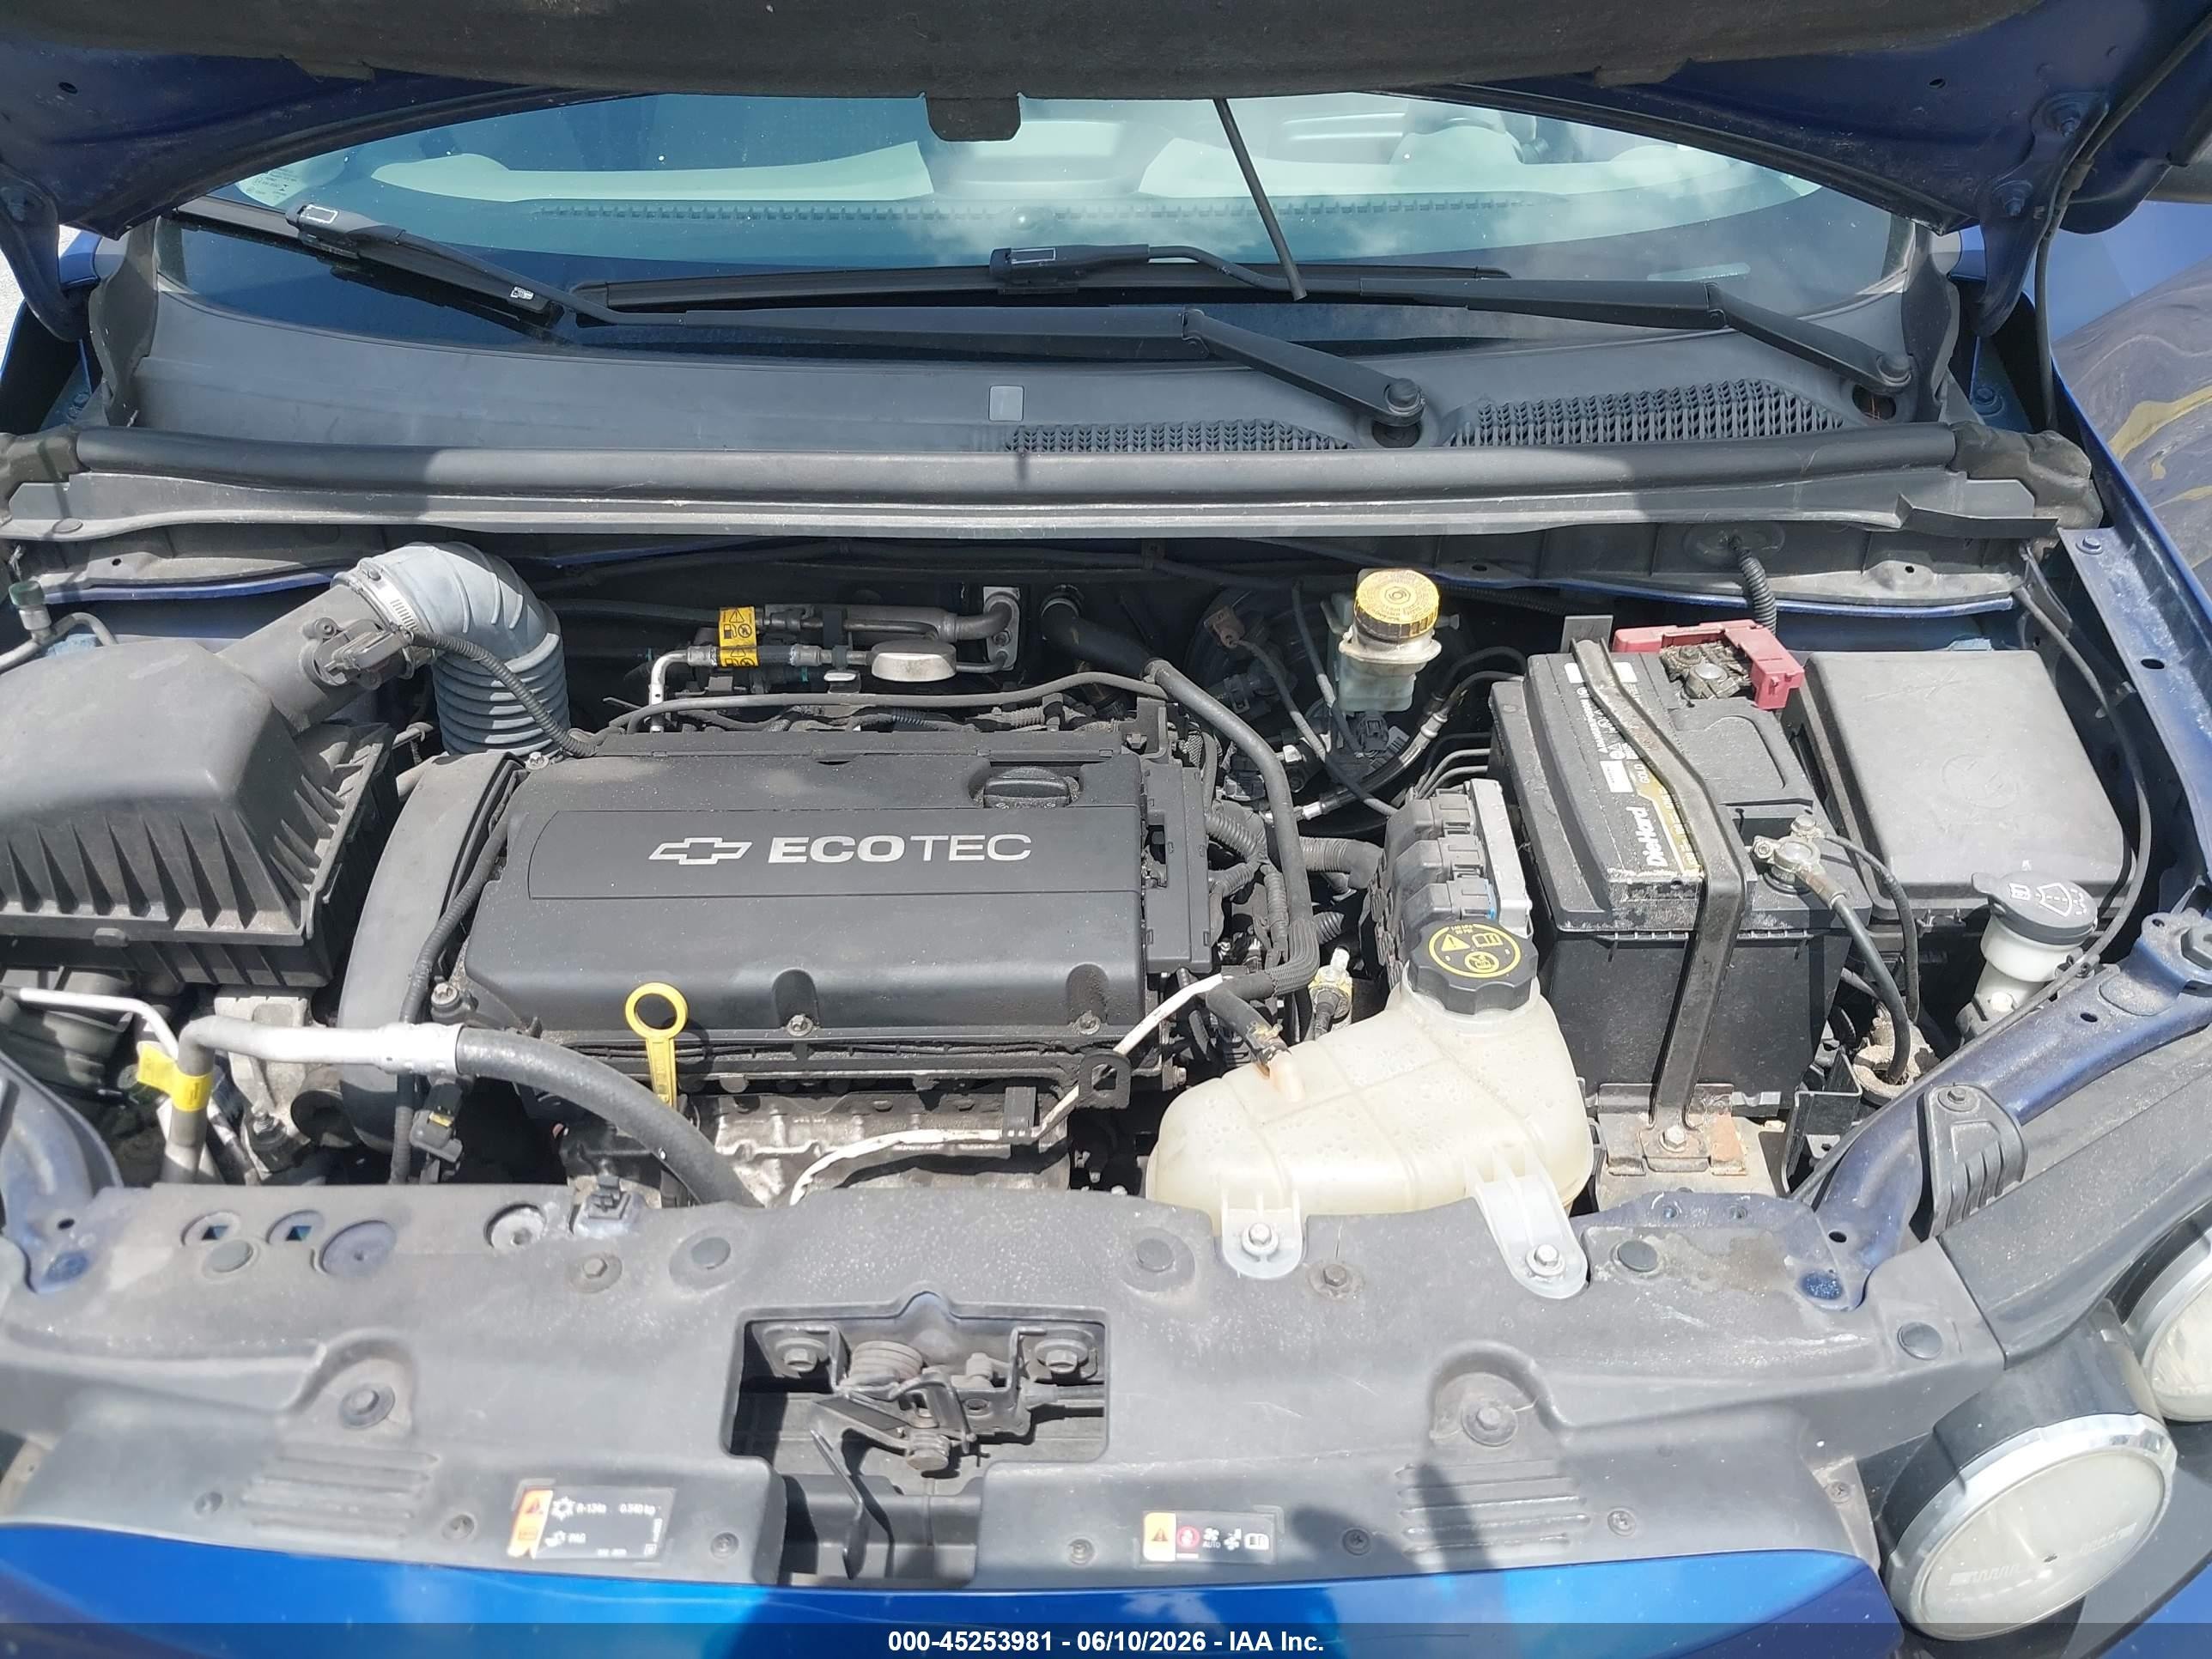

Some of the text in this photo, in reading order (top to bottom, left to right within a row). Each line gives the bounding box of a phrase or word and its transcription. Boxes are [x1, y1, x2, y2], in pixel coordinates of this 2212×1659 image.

[1635, 763, 1650, 785] GOLD
[768, 833, 1033, 864] ECOTEC
[1626, 805, 1668, 867] DieHard
